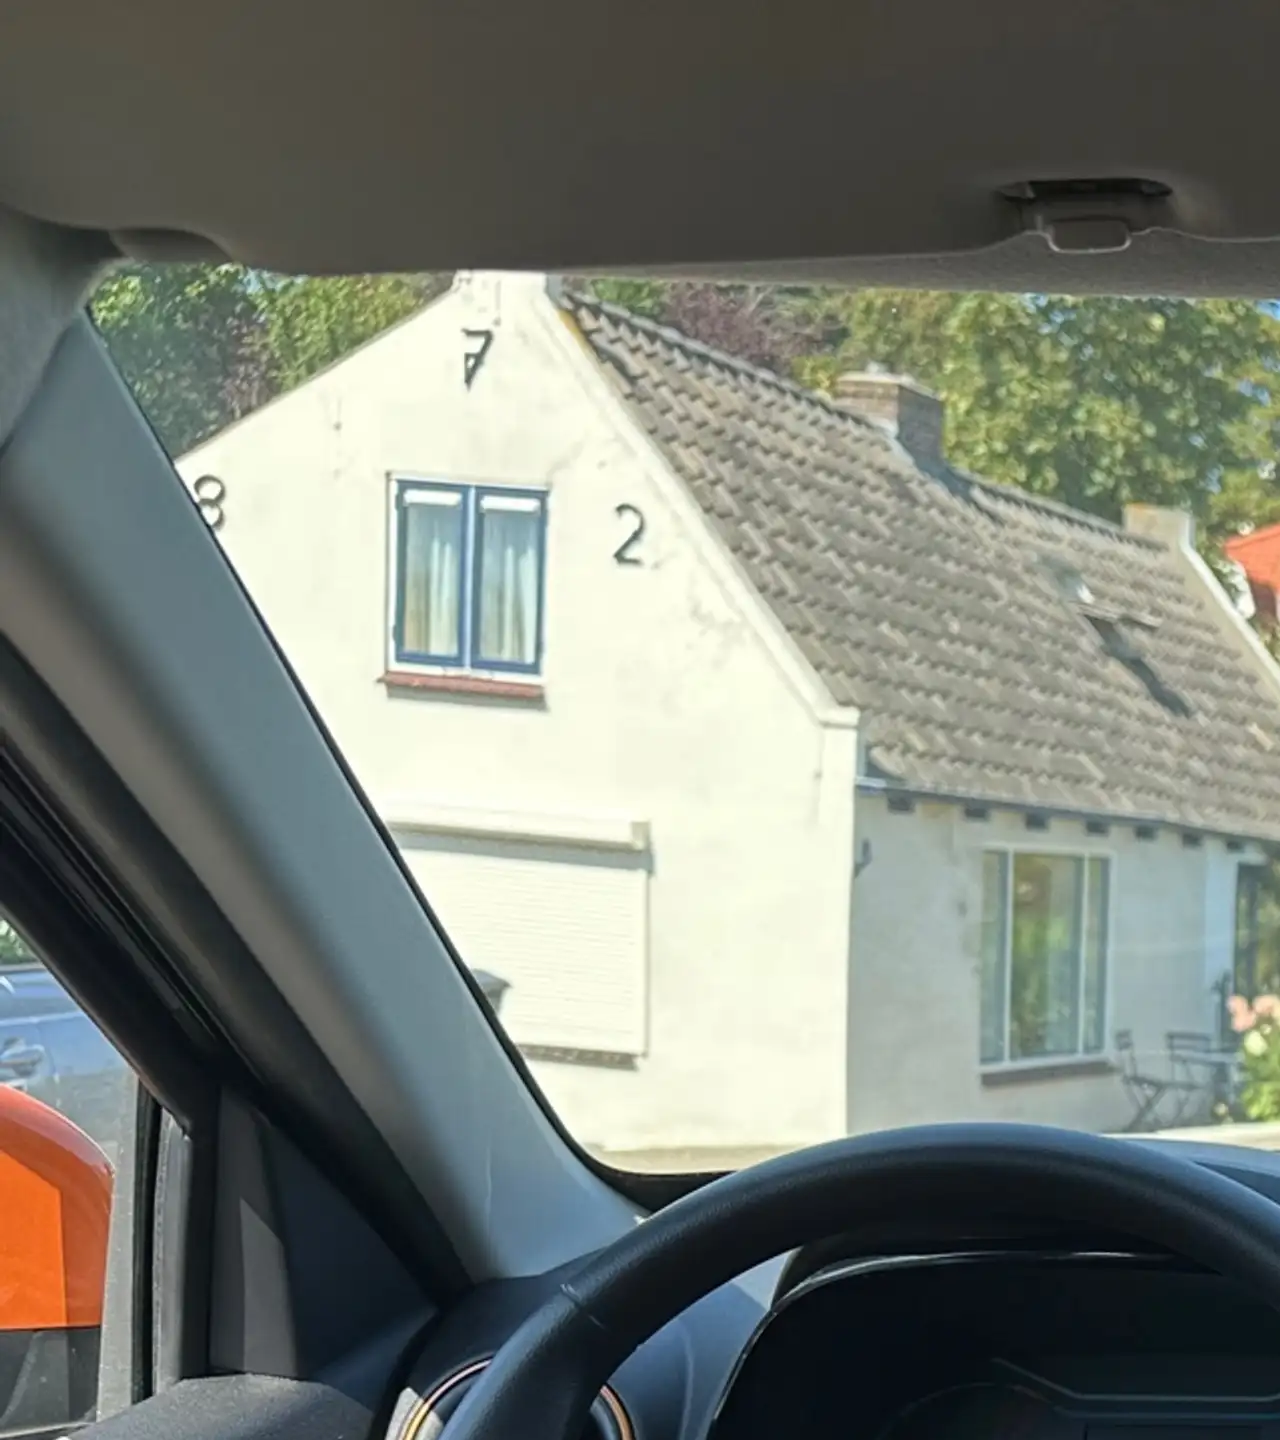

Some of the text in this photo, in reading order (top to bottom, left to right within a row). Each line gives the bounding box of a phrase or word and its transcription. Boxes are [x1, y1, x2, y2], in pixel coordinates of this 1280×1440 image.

[464, 329, 493, 388] 7
[194, 475, 226, 530] 8
[614, 504, 645, 565] 2
